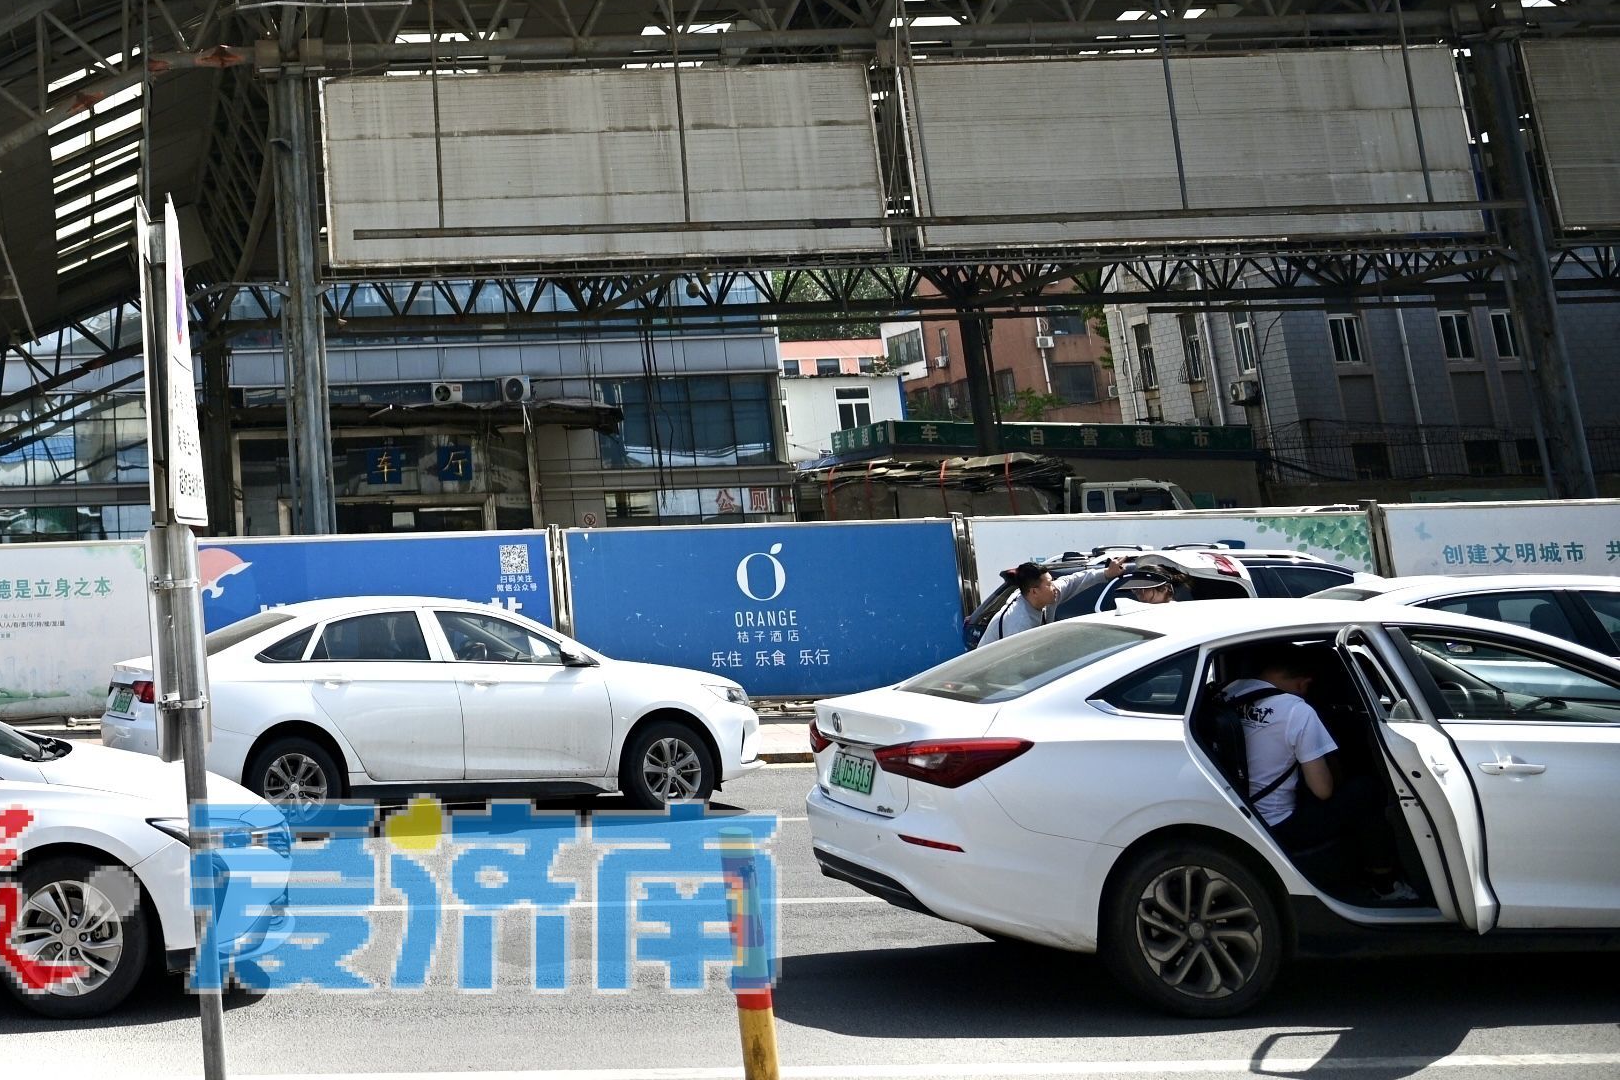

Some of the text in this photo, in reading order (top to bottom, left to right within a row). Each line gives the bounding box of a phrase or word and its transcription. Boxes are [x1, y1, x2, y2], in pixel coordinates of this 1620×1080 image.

[715, 488, 769, 512] 公厕
[1442, 541, 1584, 565] 创建文明城市
[496, 582, 538, 592] 微信公众号
[499, 574, 533, 583] 扫码关注
[734, 610, 798, 628] ORANGE
[737, 629, 800, 643] 桔子酒店
[711, 649, 831, 668] 乐住 乐食 乐行
